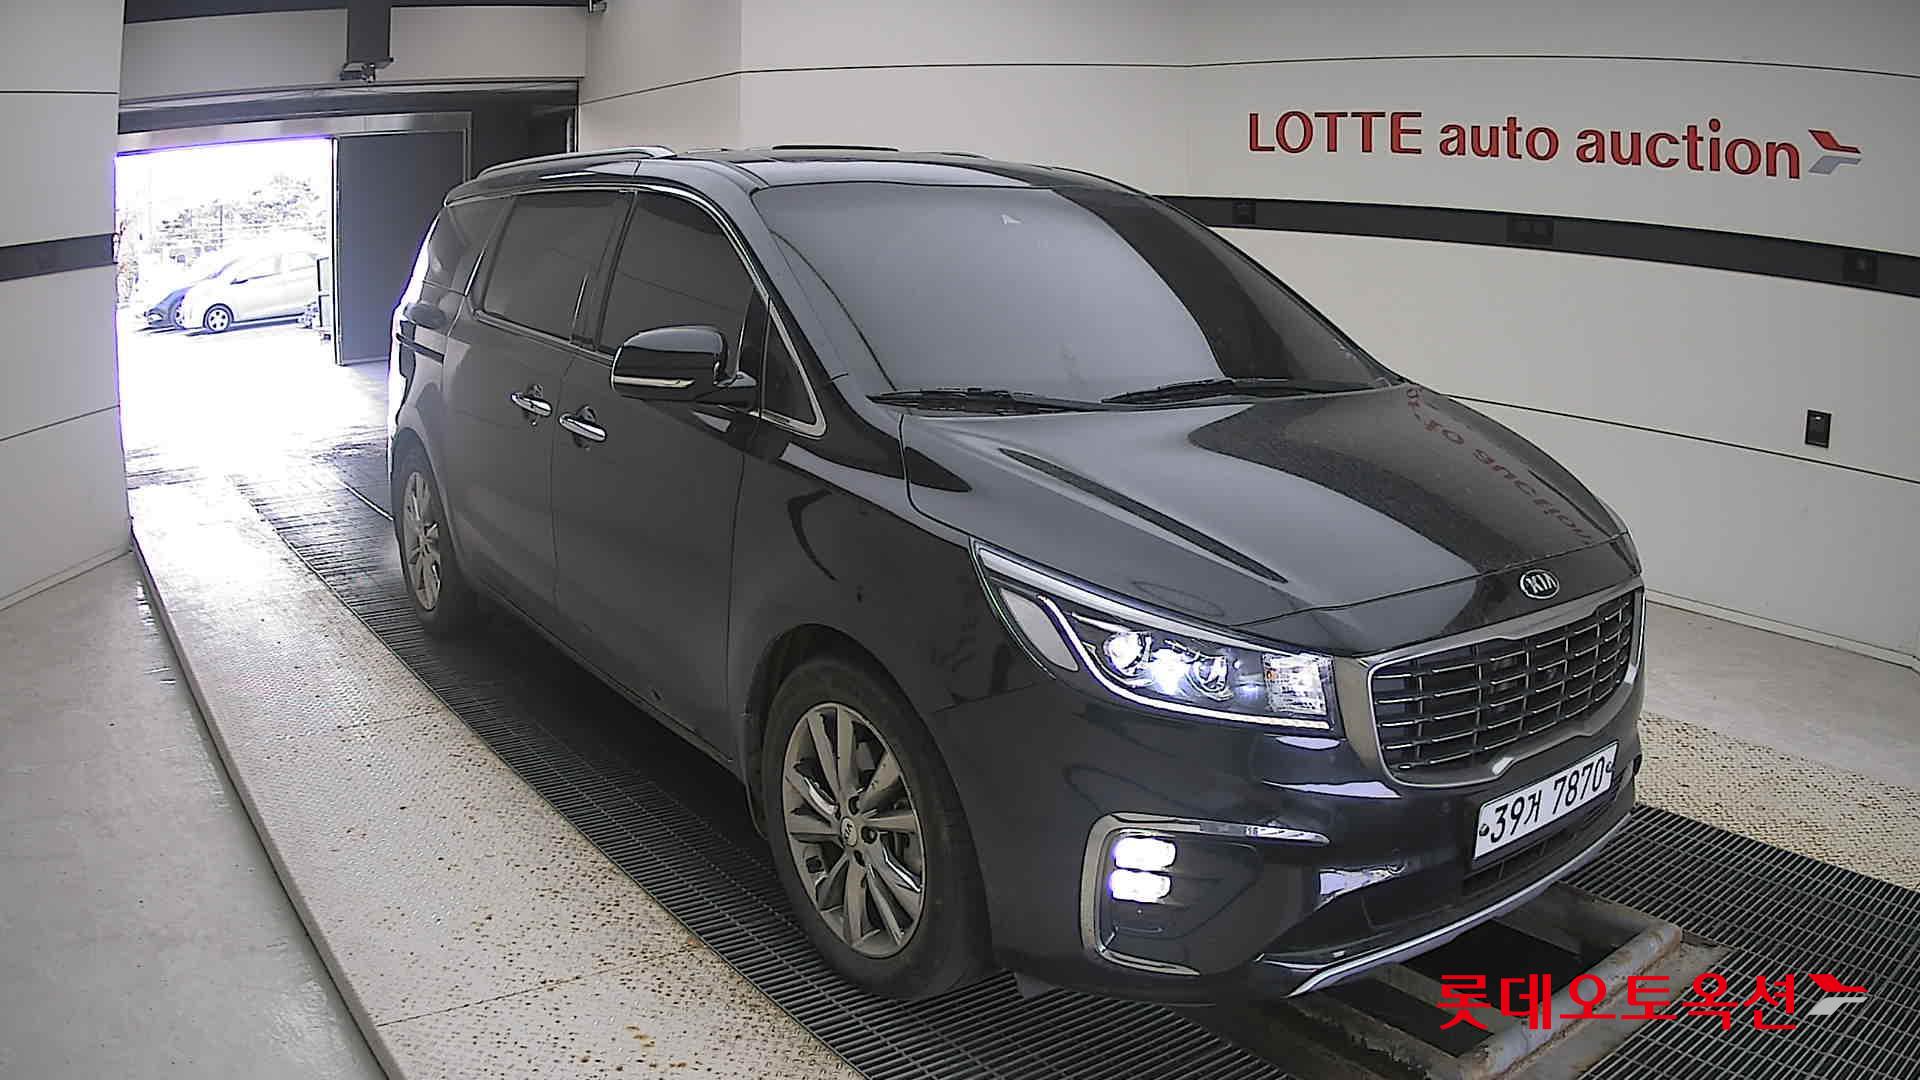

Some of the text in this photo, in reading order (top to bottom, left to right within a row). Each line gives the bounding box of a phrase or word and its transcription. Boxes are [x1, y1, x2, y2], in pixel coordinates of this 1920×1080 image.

[1249, 111, 1801, 179] LOTTE auto auction
[1524, 572, 1558, 595] KIA
[1490, 756, 1606, 843] 39거 7870
